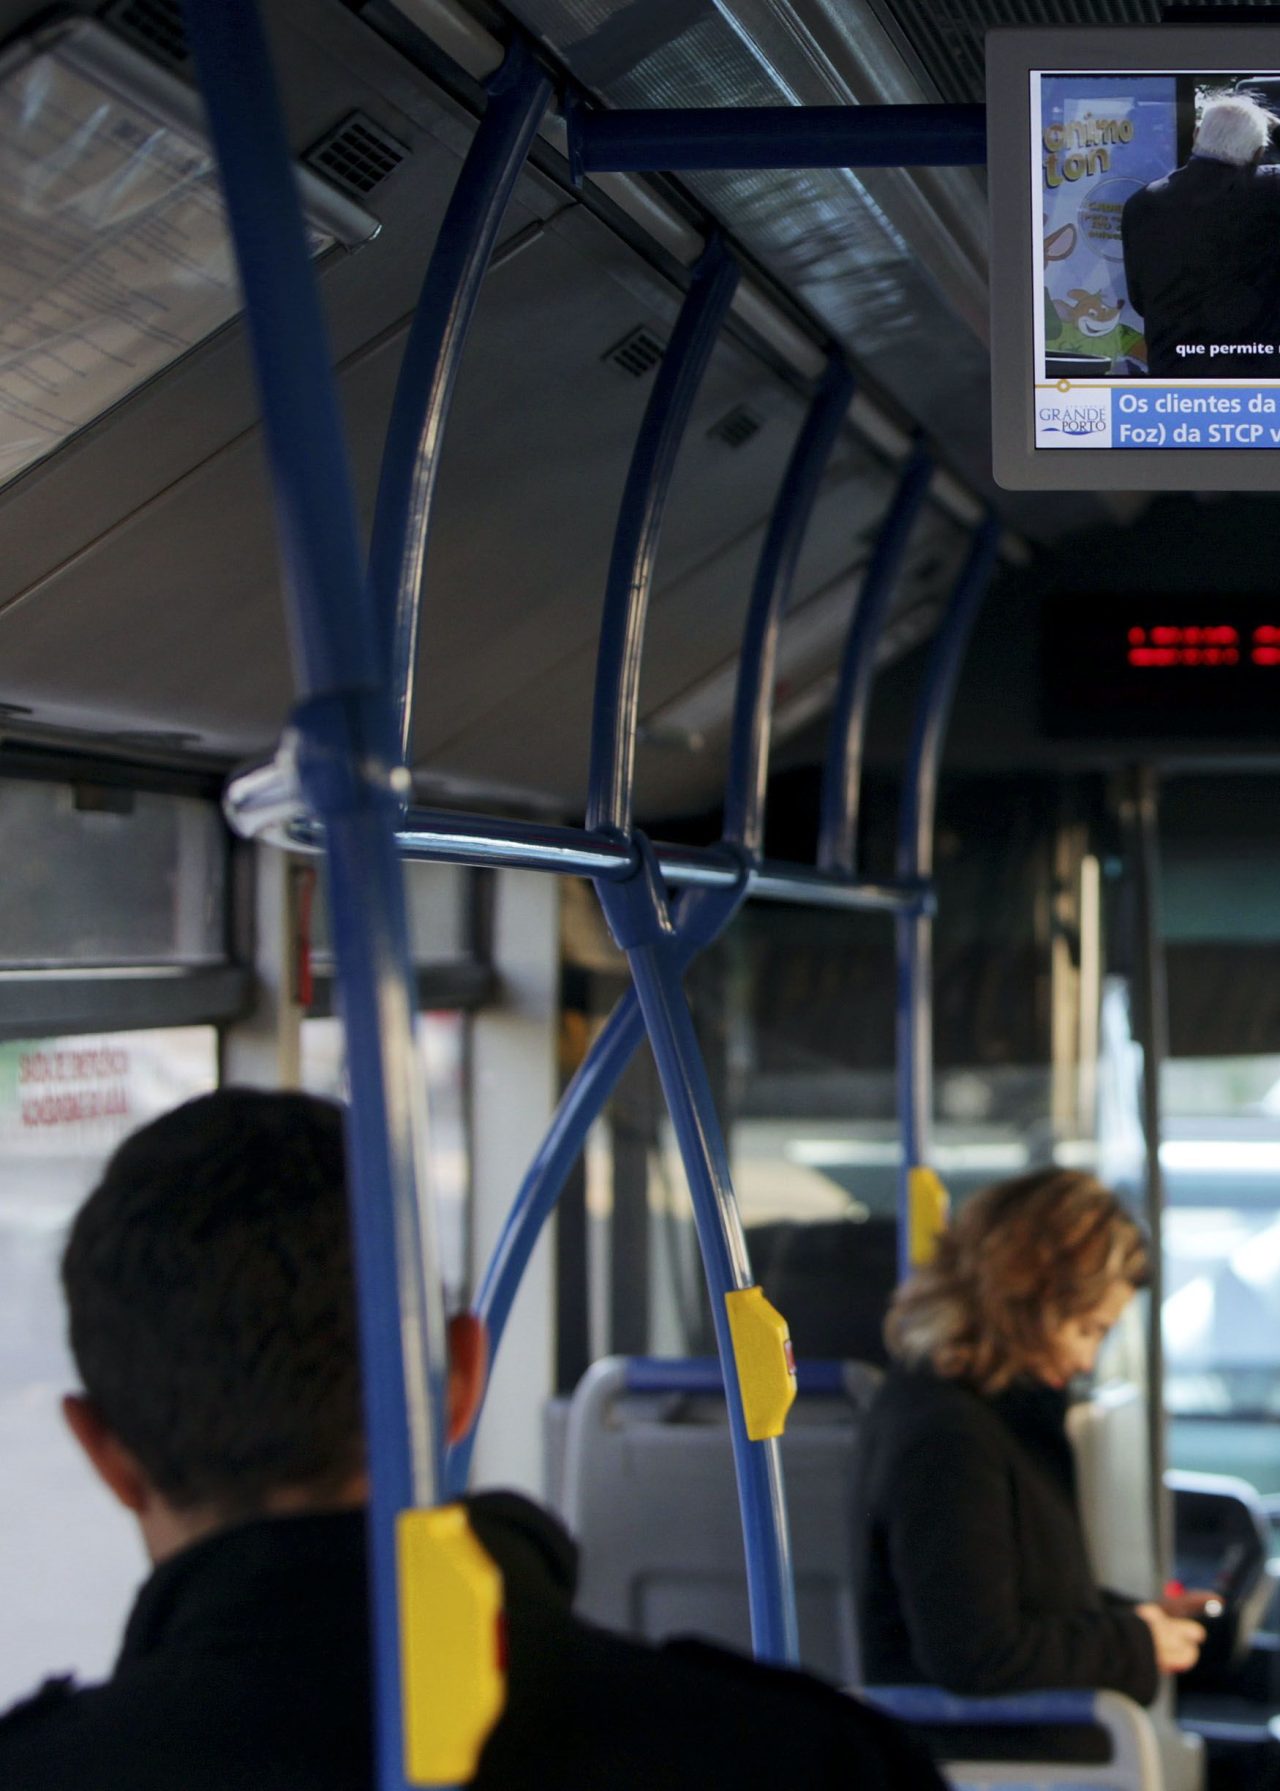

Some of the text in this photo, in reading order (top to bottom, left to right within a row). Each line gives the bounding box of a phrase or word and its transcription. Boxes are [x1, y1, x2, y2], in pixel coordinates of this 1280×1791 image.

[1175, 344, 1206, 357] que
[1210, 342, 1274, 357] permite
[1119, 394, 1149, 413] Os
[1155, 393, 1241, 413] clientes
[1248, 393, 1276, 413] da
[1039, 408, 1106, 421] GRANDE
[1062, 420, 1106, 432] PORTO
[1119, 423, 1166, 445] Foz)
[1173, 423, 1201, 443] da
[1208, 424, 1264, 443] STCP
